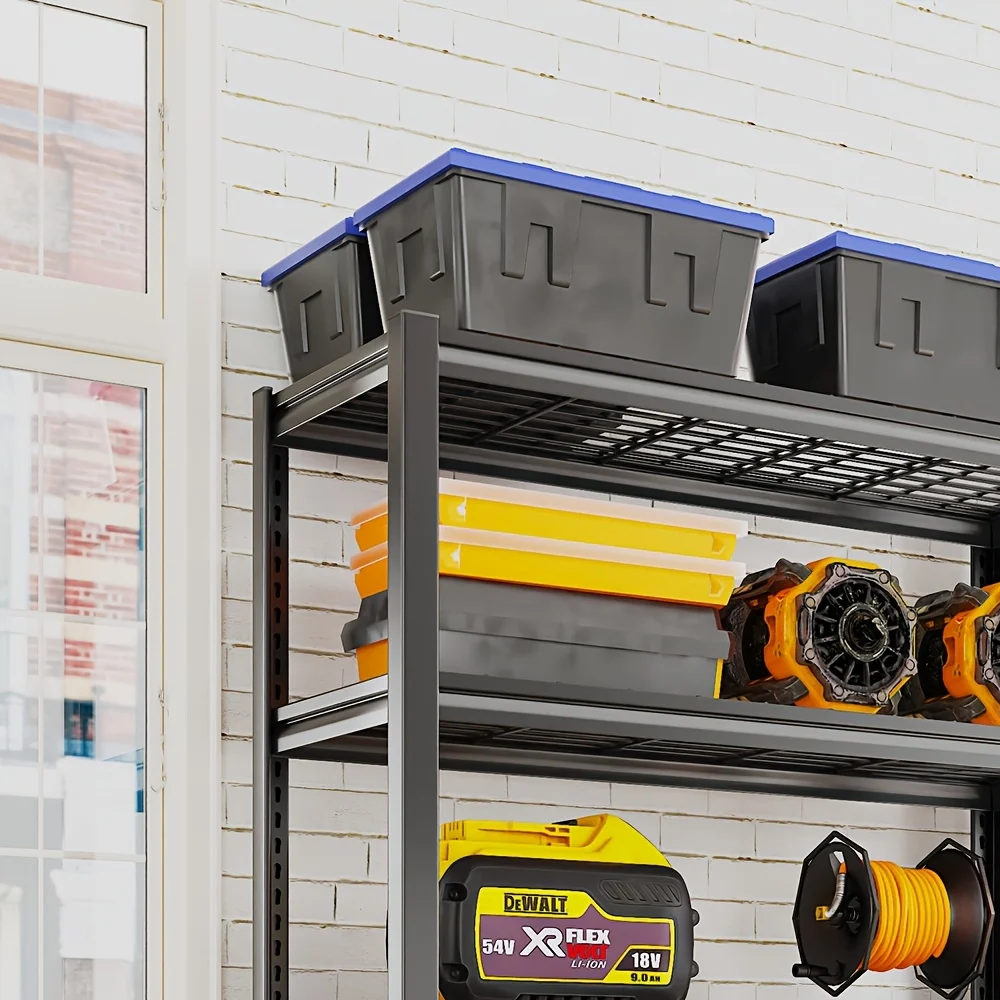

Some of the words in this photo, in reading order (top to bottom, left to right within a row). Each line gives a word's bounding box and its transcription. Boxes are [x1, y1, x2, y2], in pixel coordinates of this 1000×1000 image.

[482, 939, 515, 955] 54V
[519, 926, 567, 957] XR
[566, 928, 611, 944] FLEX
[566, 943, 608, 959] VOLT
[571, 959, 607, 969] LI-ION
[632, 952, 661, 969] 18V
[631, 972, 648, 983] 9.0
